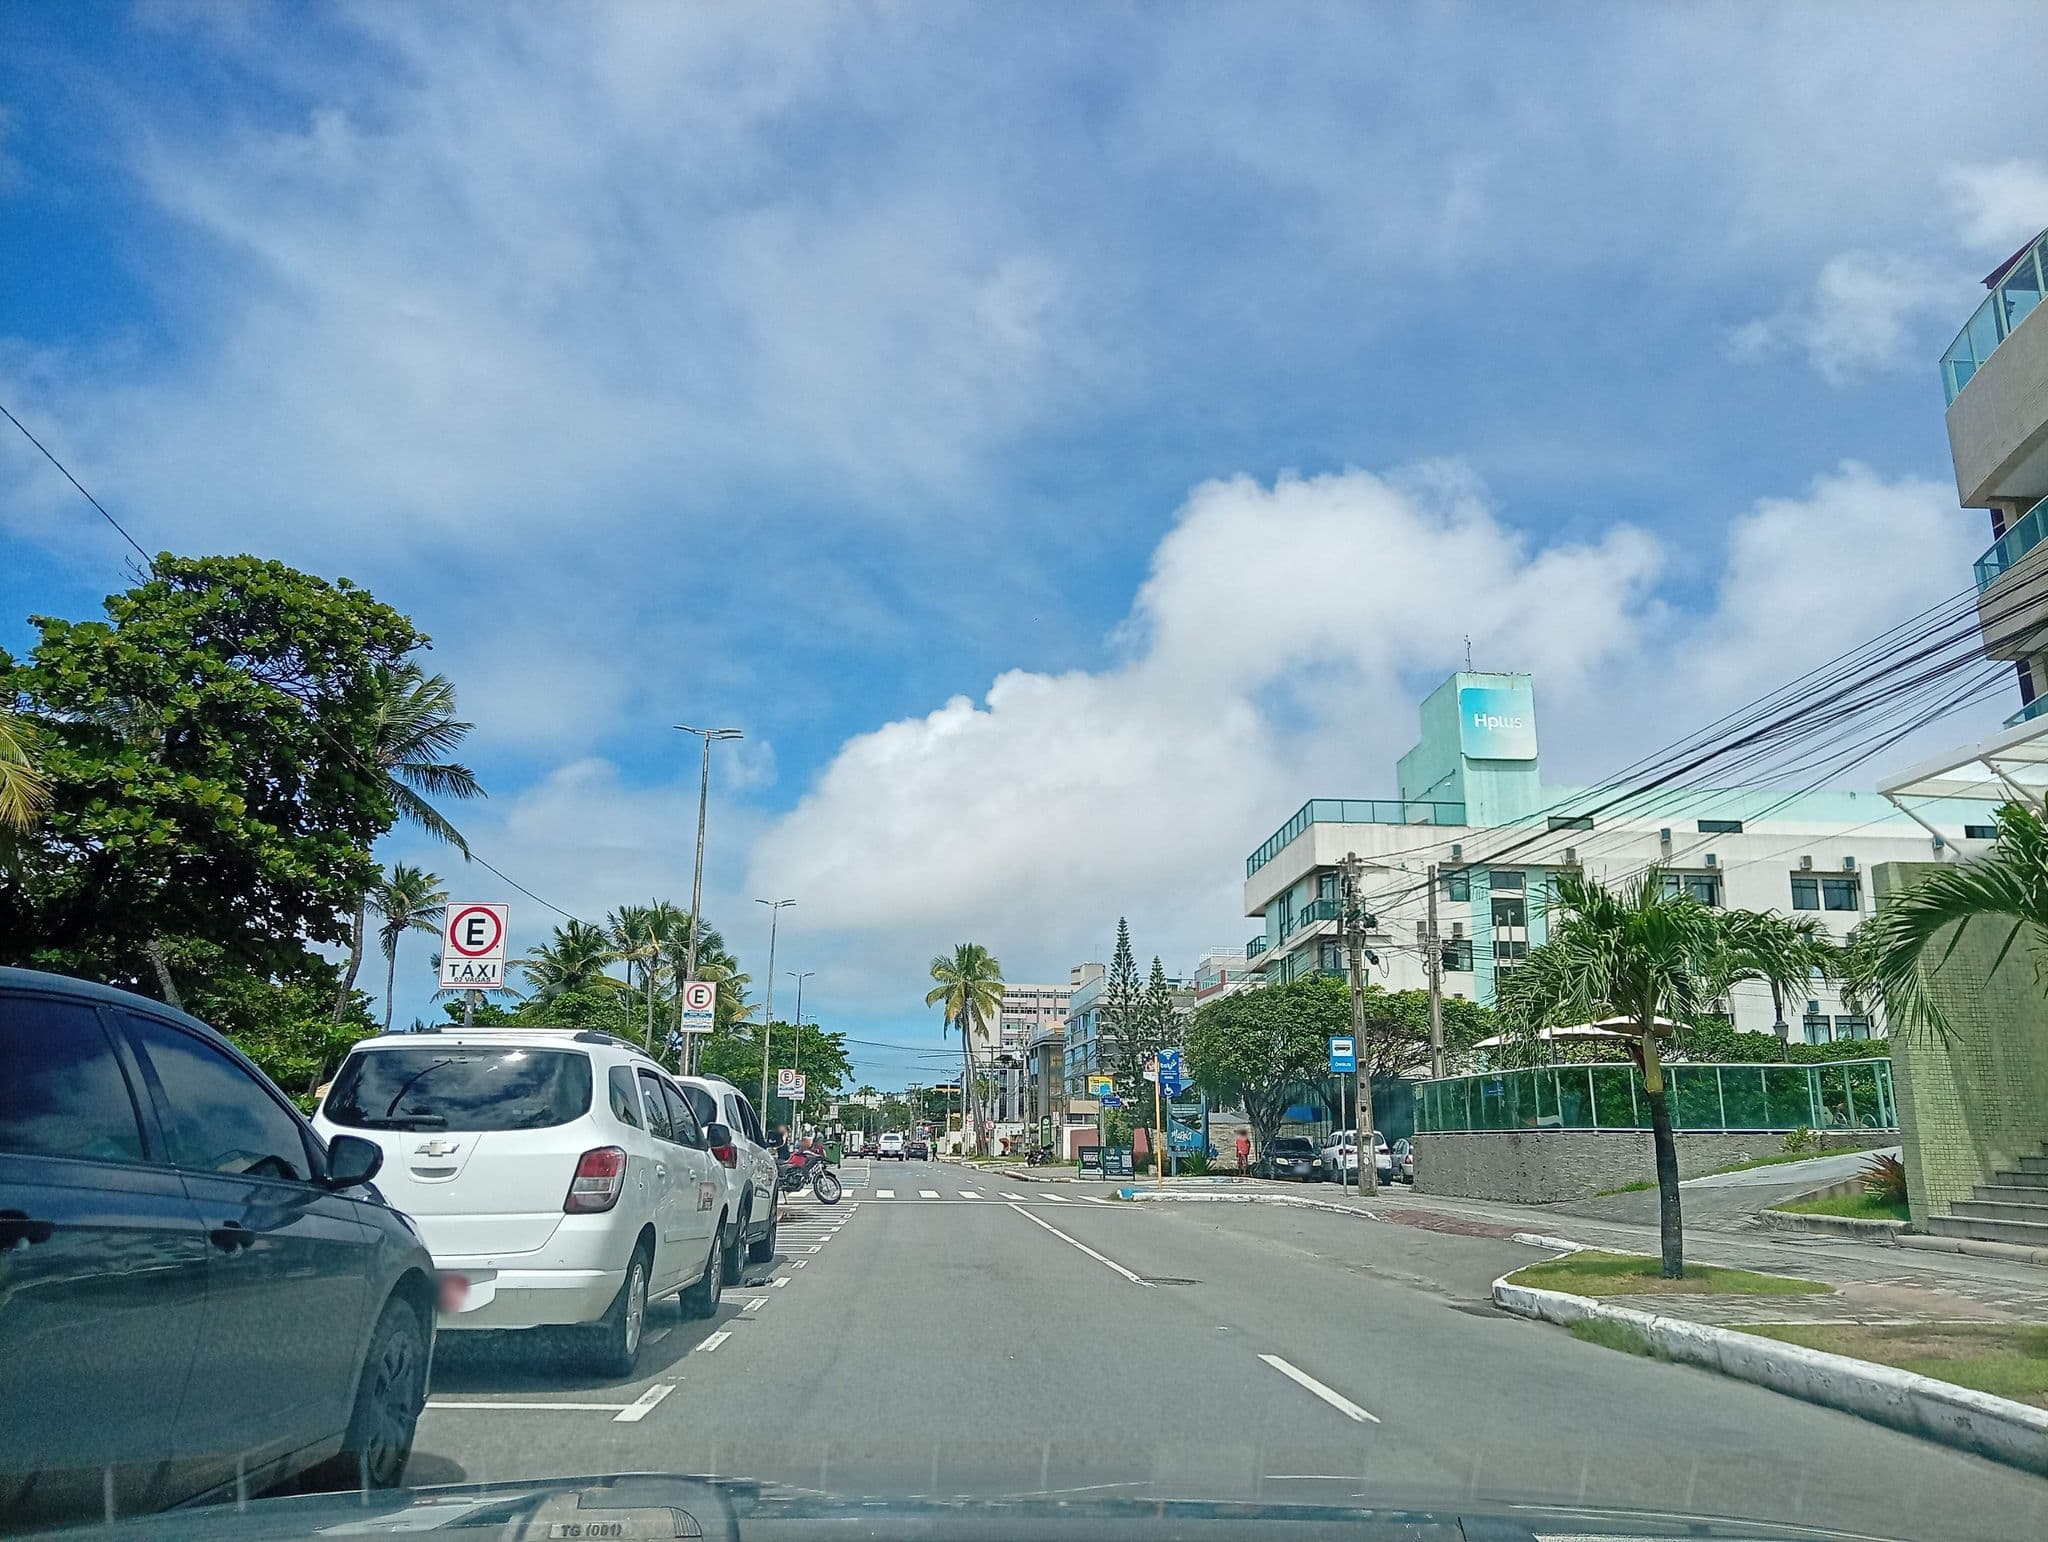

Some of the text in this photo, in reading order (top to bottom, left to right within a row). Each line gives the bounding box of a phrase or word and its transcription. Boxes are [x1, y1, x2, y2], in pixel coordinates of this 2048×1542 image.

[1473, 713, 1522, 731] Hplus
[466, 918, 486, 946] E
[449, 961, 496, 978] TÁXI
[694, 989, 704, 1004] E
[784, 1073, 790, 1081] E
[795, 1078, 801, 1086] E
[561, 1524, 581, 1537] TG
